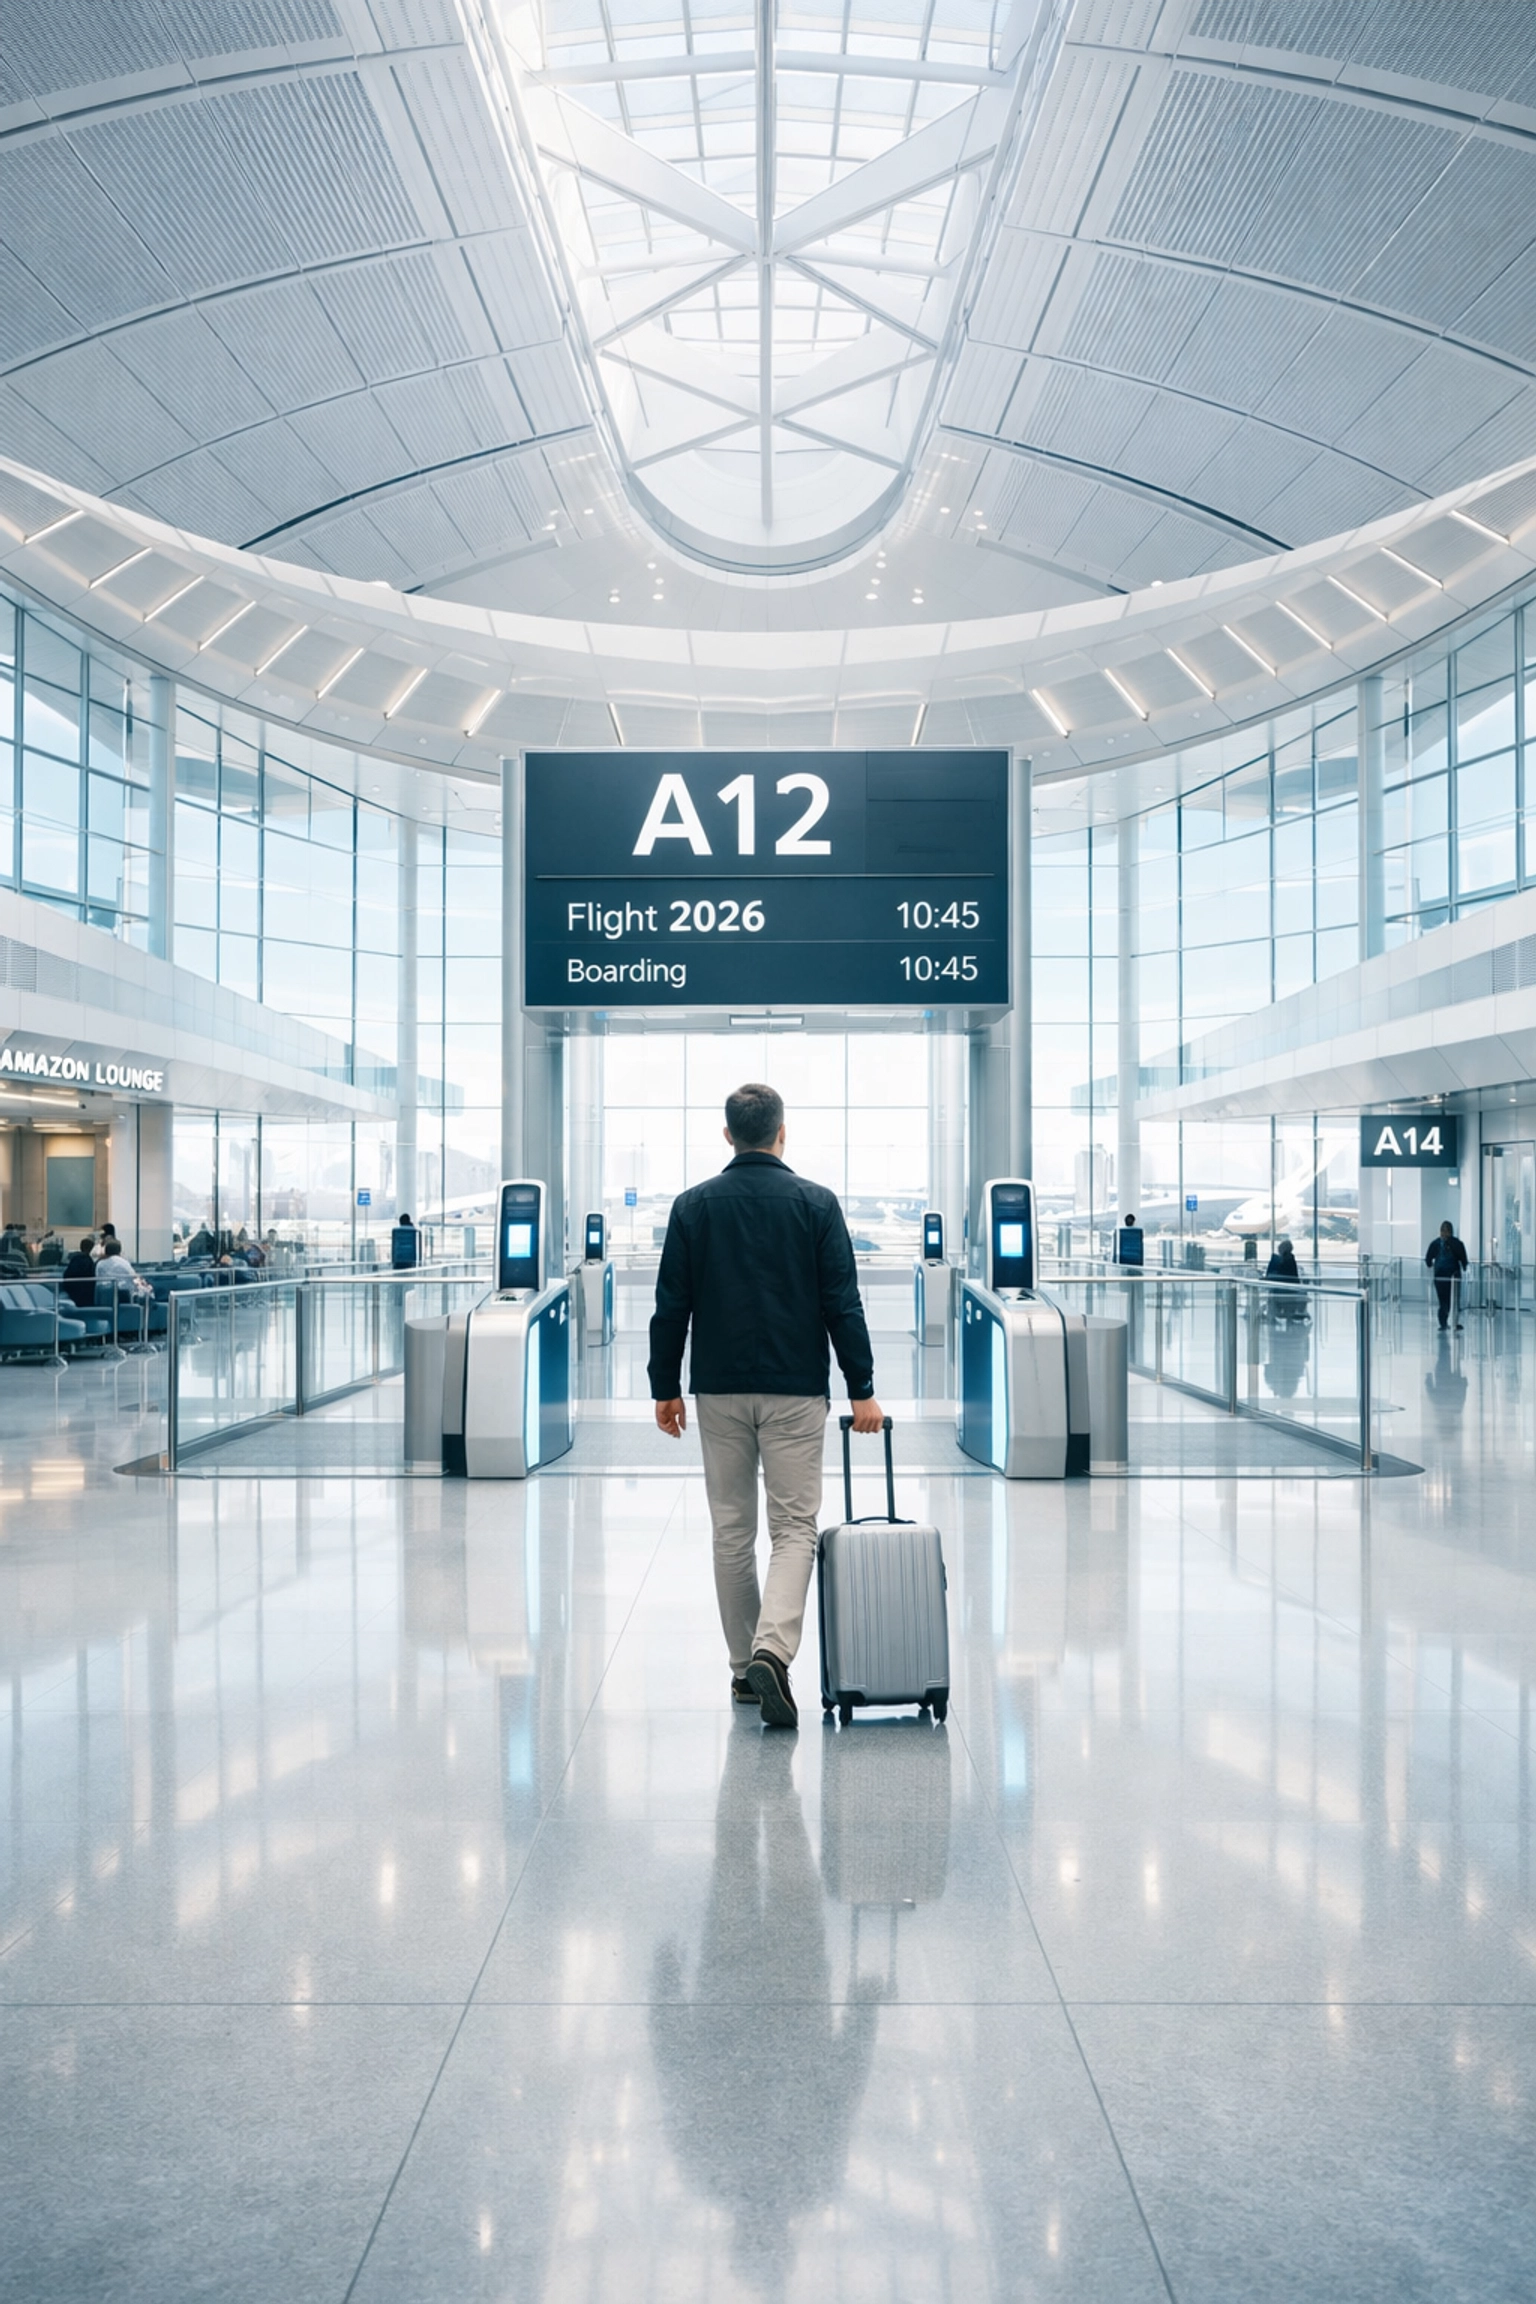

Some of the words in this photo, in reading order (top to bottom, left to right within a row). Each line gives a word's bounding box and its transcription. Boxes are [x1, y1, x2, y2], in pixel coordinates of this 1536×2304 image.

[633, 772, 832, 856] A12
[568, 902, 658, 939] Flight
[669, 899, 766, 933] 2026
[896, 901, 980, 930] 10:45
[568, 958, 687, 988] Boarding
[899, 955, 978, 981] 10:45
[0, 1049, 89, 1081] AMAZON
[95, 1062, 164, 1091] LOUNGE
[1373, 1126, 1444, 1156] A14
